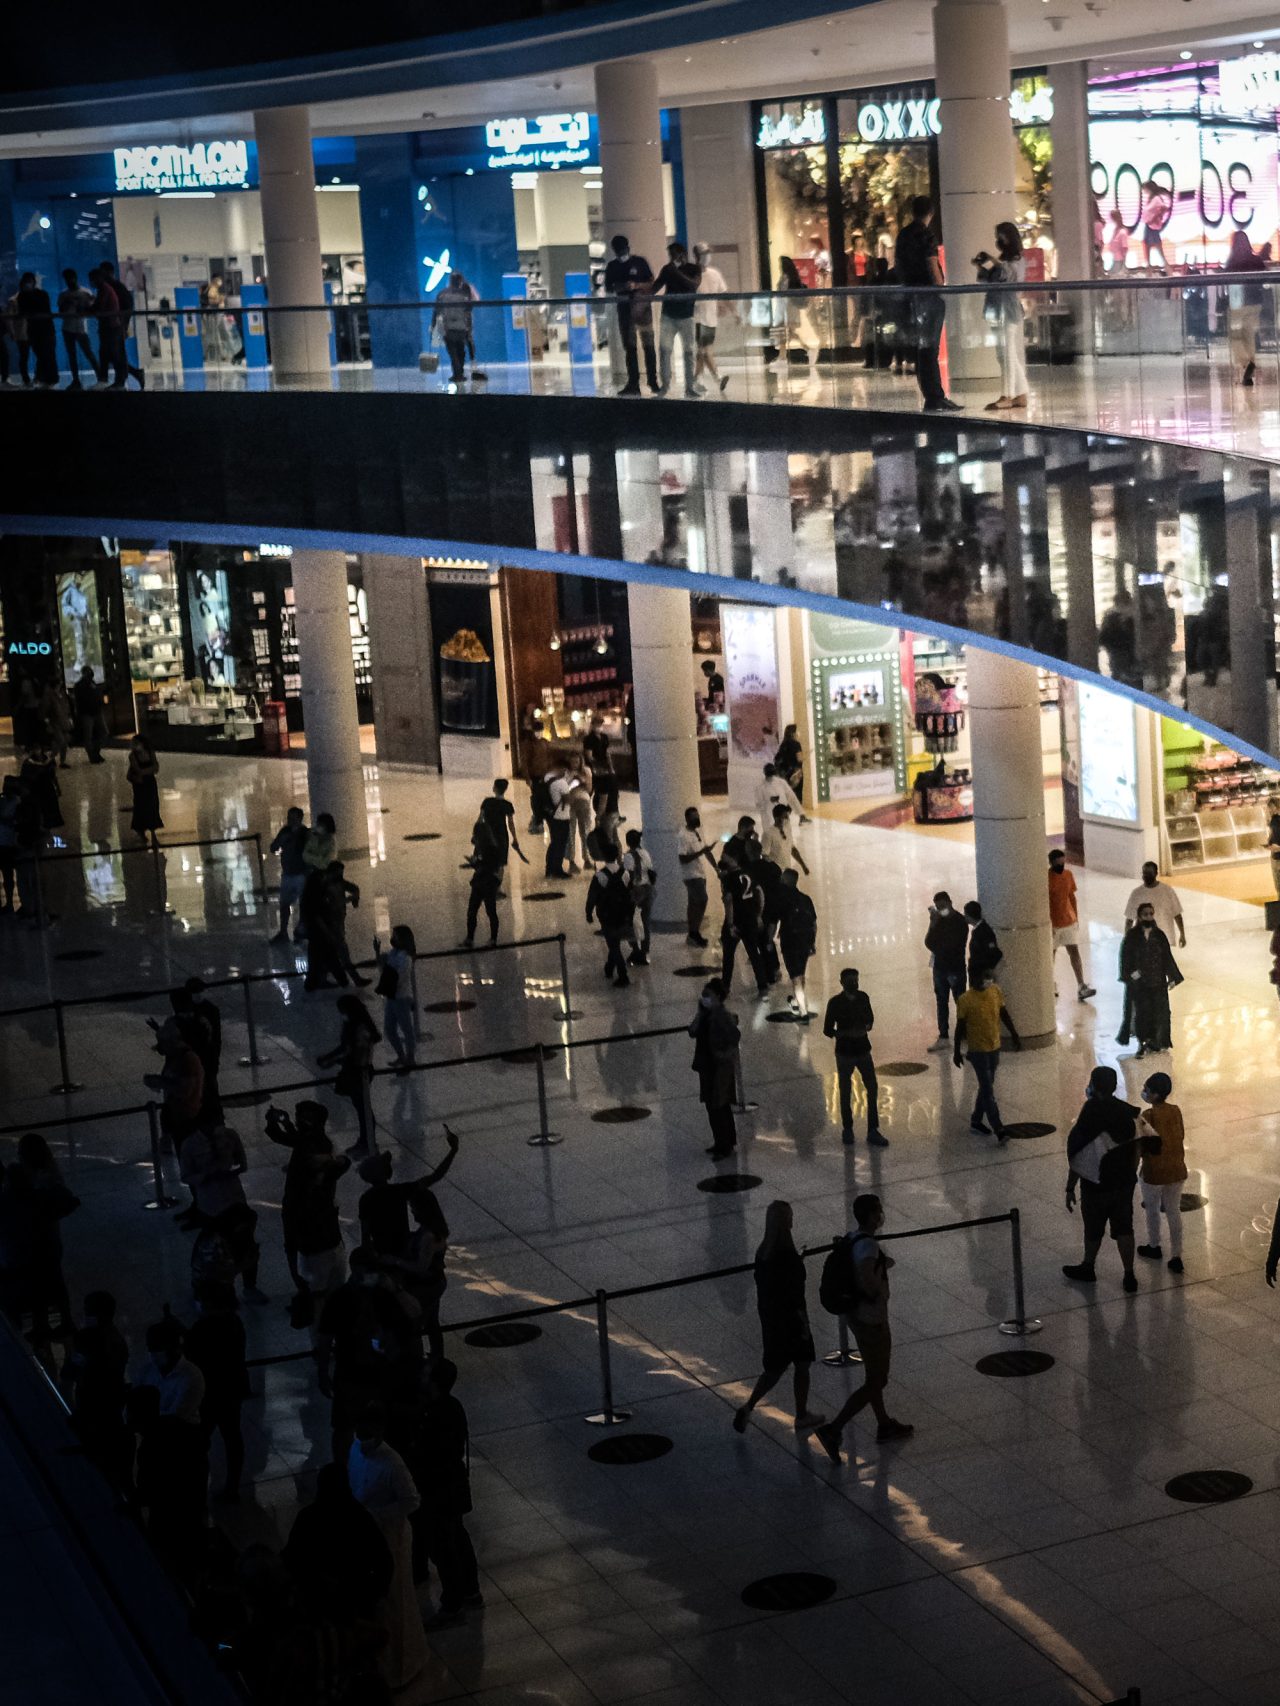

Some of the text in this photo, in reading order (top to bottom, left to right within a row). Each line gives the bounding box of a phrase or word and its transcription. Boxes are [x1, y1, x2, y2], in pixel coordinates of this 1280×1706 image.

[114, 140, 247, 178] DECATHLON
[9, 642, 51, 655] ALDO
[739, 874, 753, 899] 2
